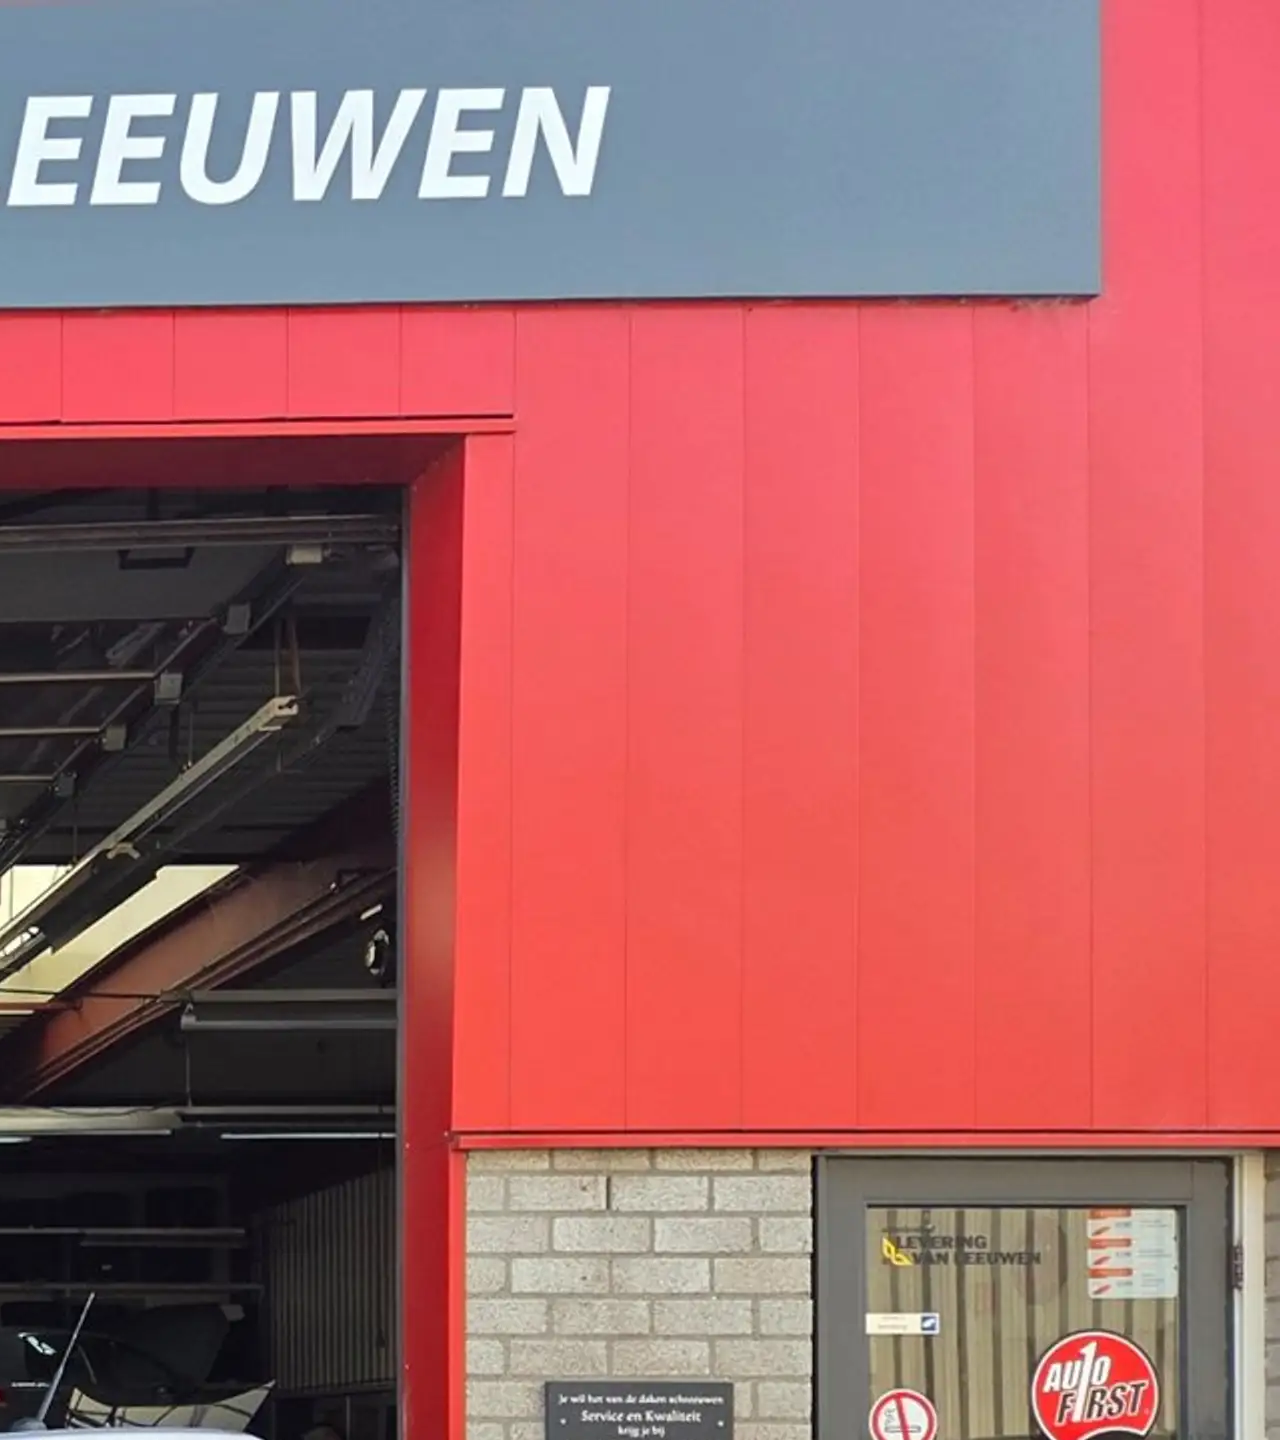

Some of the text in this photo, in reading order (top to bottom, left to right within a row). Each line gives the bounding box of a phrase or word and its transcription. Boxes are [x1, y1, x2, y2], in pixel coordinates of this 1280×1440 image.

[897, 1235, 987, 1249] LEVERING
[912, 1252, 950, 1265] VAN
[581, 1410, 702, 1423] Service en Kwaliteit
